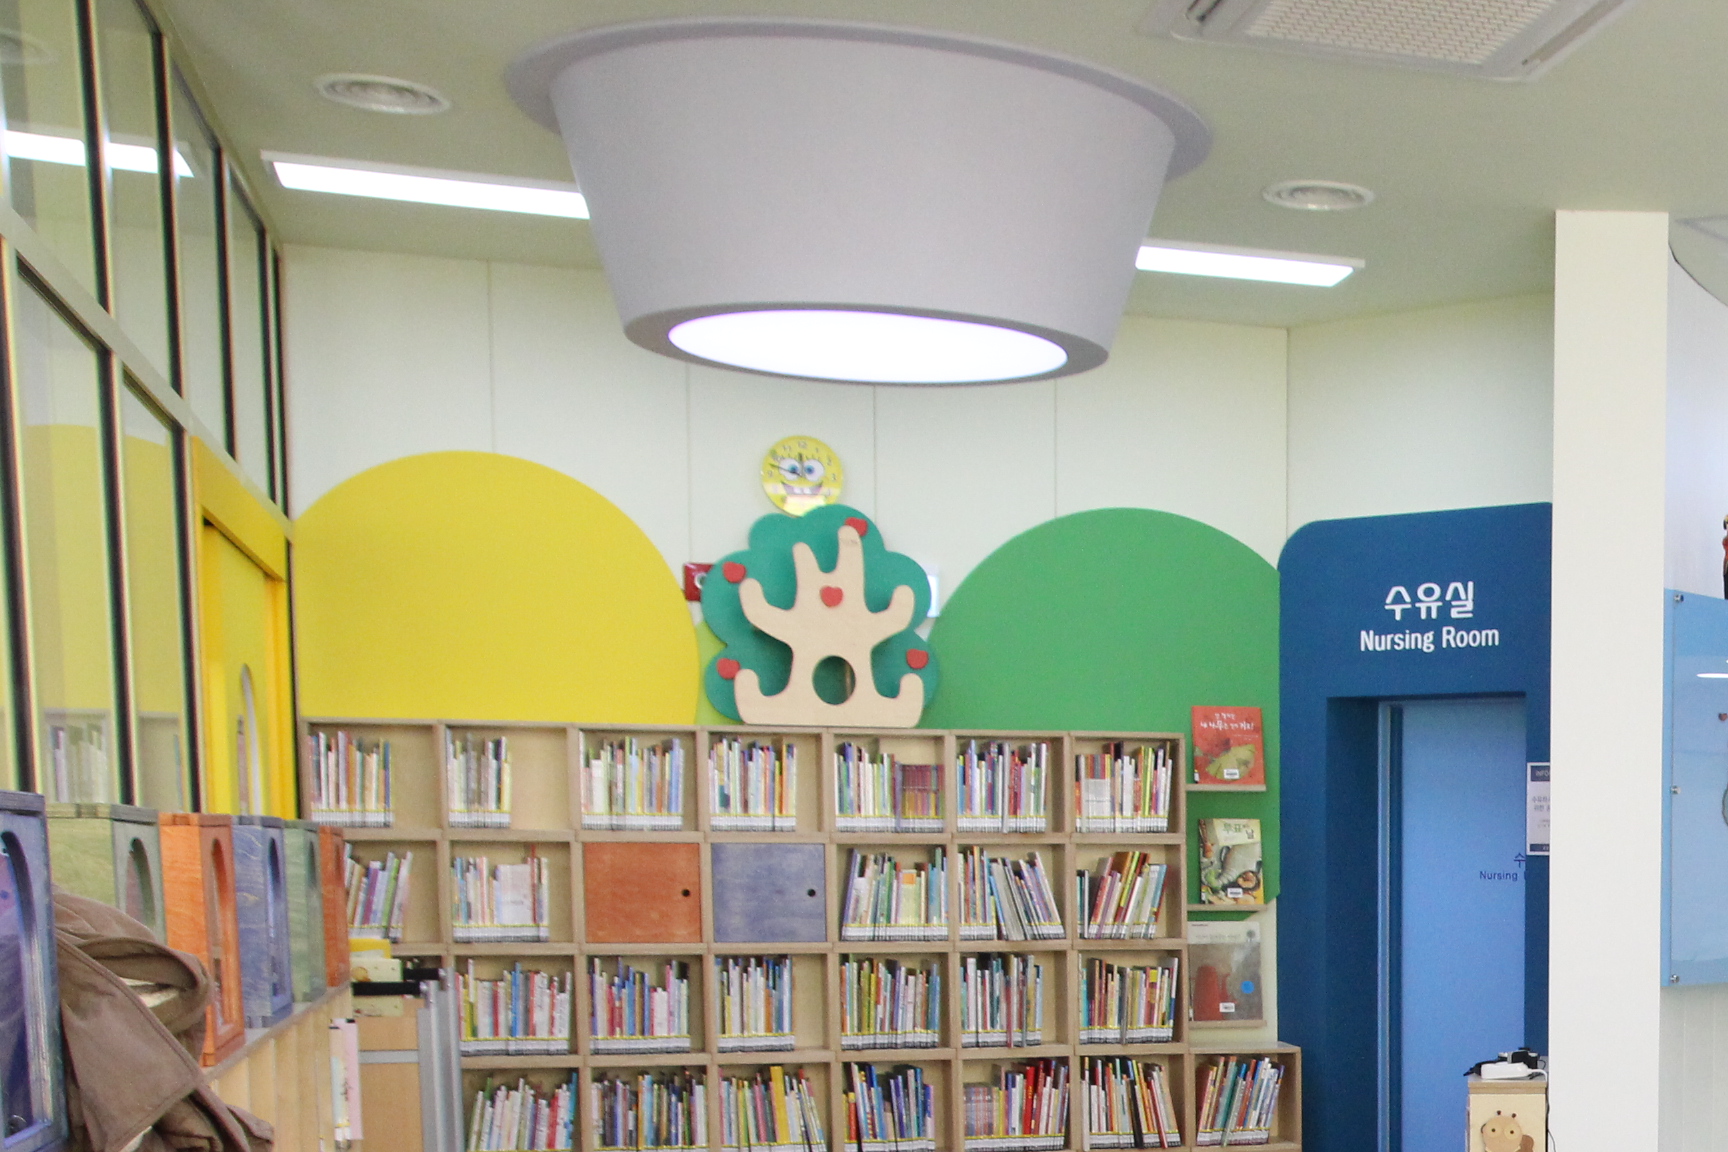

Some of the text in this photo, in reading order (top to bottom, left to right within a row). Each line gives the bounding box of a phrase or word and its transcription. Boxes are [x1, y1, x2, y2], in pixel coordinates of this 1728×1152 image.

[1384, 580, 1475, 621] 수유실
[1360, 625, 1500, 653] Nursing Room
[1480, 870, 1518, 882] Nursing
